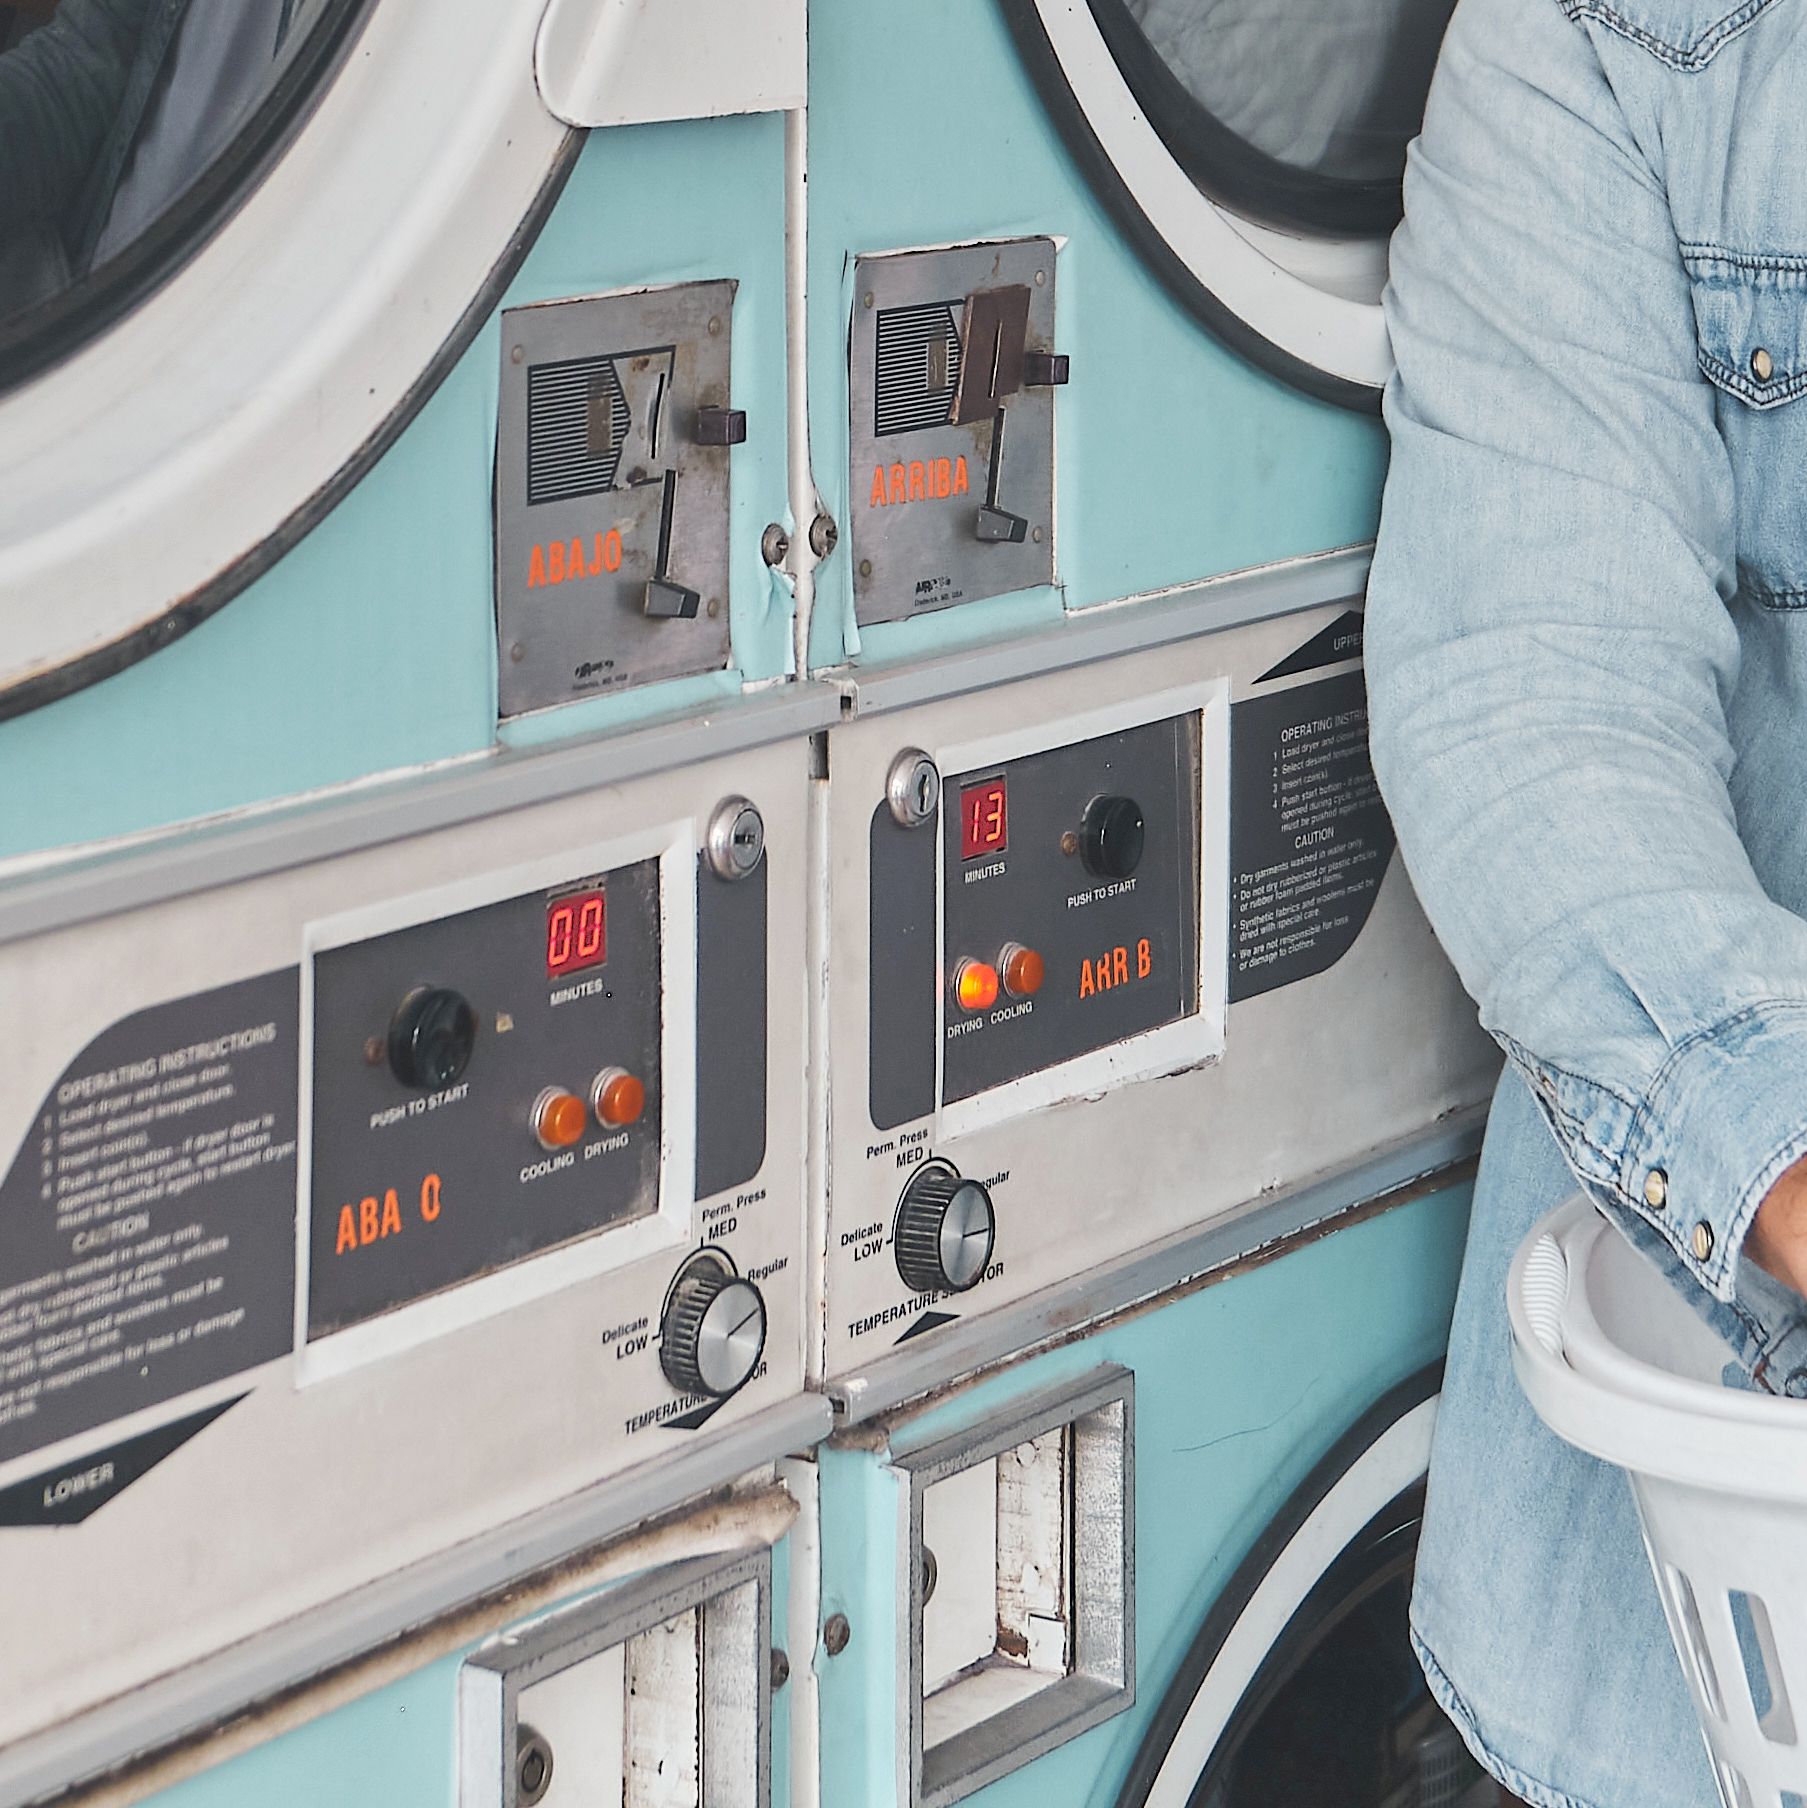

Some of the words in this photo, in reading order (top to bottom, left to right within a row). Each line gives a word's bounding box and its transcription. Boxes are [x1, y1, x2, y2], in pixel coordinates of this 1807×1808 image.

[870, 455, 970, 508] ARRIBA
[527, 529, 622, 589] ABAJO
[1282, 717, 1333, 742] OPERATING
[1336, 708, 1368, 727] INSTRU
[1274, 768, 1278, 777] 2
[973, 791, 1004, 843] 13
[1296, 826, 1334, 849] CAUTION
[965, 862, 1006, 883] MINUTES
[1067, 890, 1092, 909] PUSH
[1093, 886, 1106, 901] TO
[1108, 879, 1137, 898] START
[1241, 889, 1251, 901] Do
[1241, 903, 1248, 913] or
[548, 898, 604, 967] 00
[1137, 938, 1151, 979] B
[550, 978, 603, 1006] MINUTES
[947, 1017, 983, 1039] DRYING
[990, 1001, 1033, 1025] COOLING
[370, 1106, 406, 1130] PUSH
[408, 1097, 426, 1114] TO
[427, 1083, 469, 1111] START
[899, 1128, 929, 1147] Press
[519, 1153, 575, 1183] COOLING
[584, 1133, 629, 1160] DRYING
[896, 1147, 923, 1169] MED
[981, 1170, 1010, 1190] gular
[736, 1188, 767, 1208] Press
[335, 1187, 402, 1256] ABA
[708, 1217, 737, 1241] MED
[841, 1222, 883, 1247] Delicate
[854, 1239, 883, 1262] LOW
[747, 1257, 789, 1282] Regular
[848, 1290, 938, 1339] TEMPERATURE
[602, 1318, 649, 1344] Delicate
[616, 1336, 649, 1360] LOW
[43, 1461, 114, 1507] LOWER
